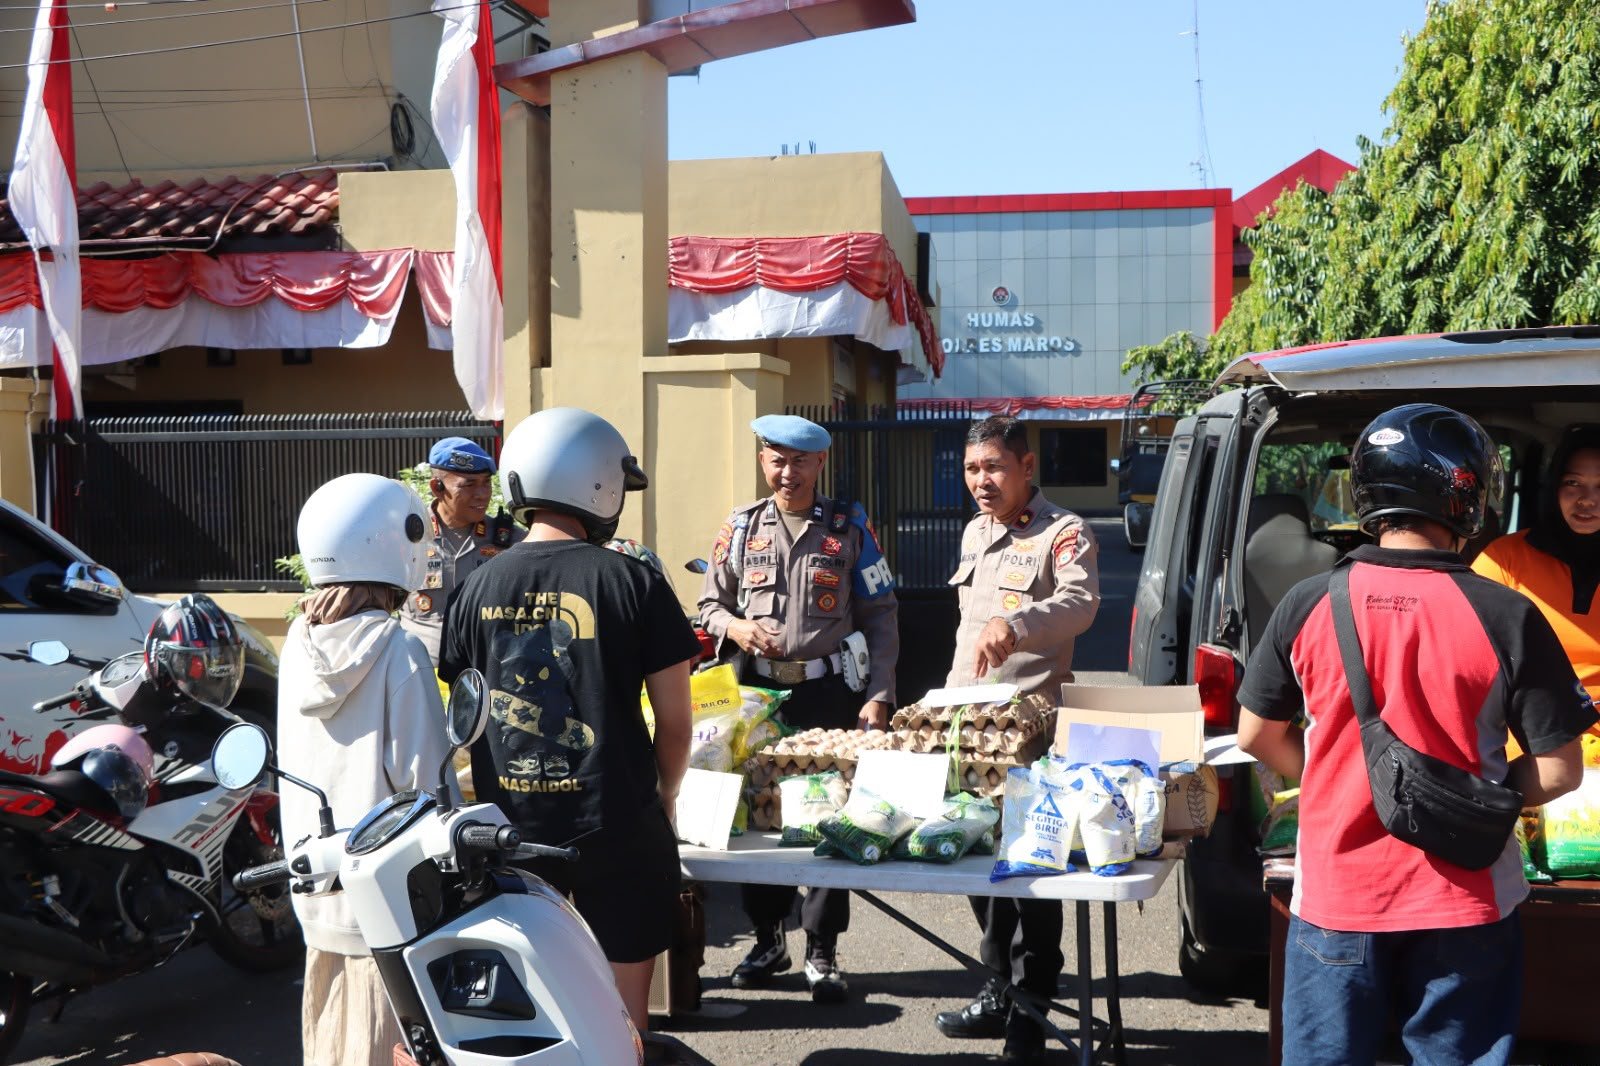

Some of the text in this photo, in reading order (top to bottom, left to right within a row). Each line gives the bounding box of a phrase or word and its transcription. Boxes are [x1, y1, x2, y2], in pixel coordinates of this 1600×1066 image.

[967, 312, 1035, 327] HUMAS
[1007, 336, 1075, 352] MAROS
[812, 556, 846, 568] POLRI
[1003, 554, 1037, 567] POLRI
[525, 592, 558, 606] THE
[701, 698, 730, 708] BULOG
[499, 776, 582, 793] NASAIDOL
[1025, 813, 1069, 830] SEGITIGA
[1035, 823, 1059, 835] BIRU
